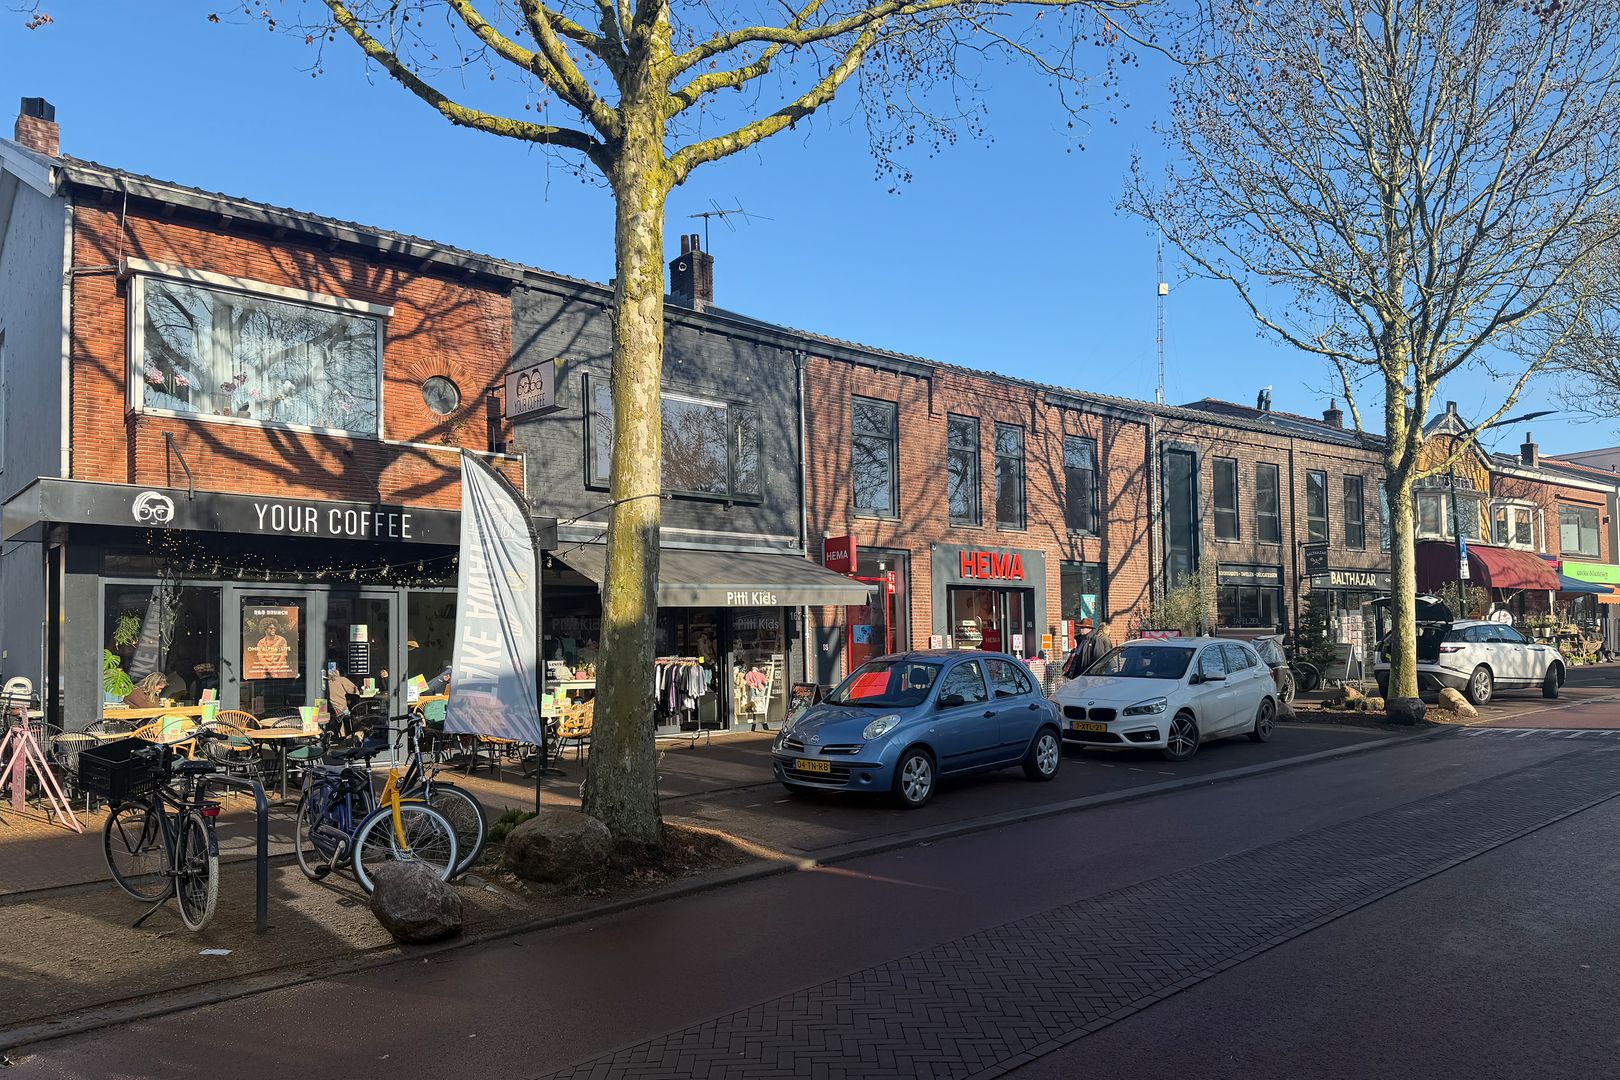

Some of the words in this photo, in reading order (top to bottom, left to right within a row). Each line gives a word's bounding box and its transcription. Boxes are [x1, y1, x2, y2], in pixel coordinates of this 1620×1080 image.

[514, 398, 527, 413] YOUR
[528, 393, 545, 410] COFFEE
[254, 503, 318, 533] YOUR
[328, 508, 412, 538] COFFEE
[826, 551, 848, 561] HEMA
[960, 550, 1025, 580] HEMA
[1331, 571, 1376, 586] BALTHAZAR
[727, 592, 748, 604] Pitti
[752, 592, 777, 604] Kids
[581, 616, 600, 630] Kid
[738, 619, 756, 629] Pitti
[759, 619, 780, 630] Kids
[797, 761, 829, 771] 04-TN-RB
